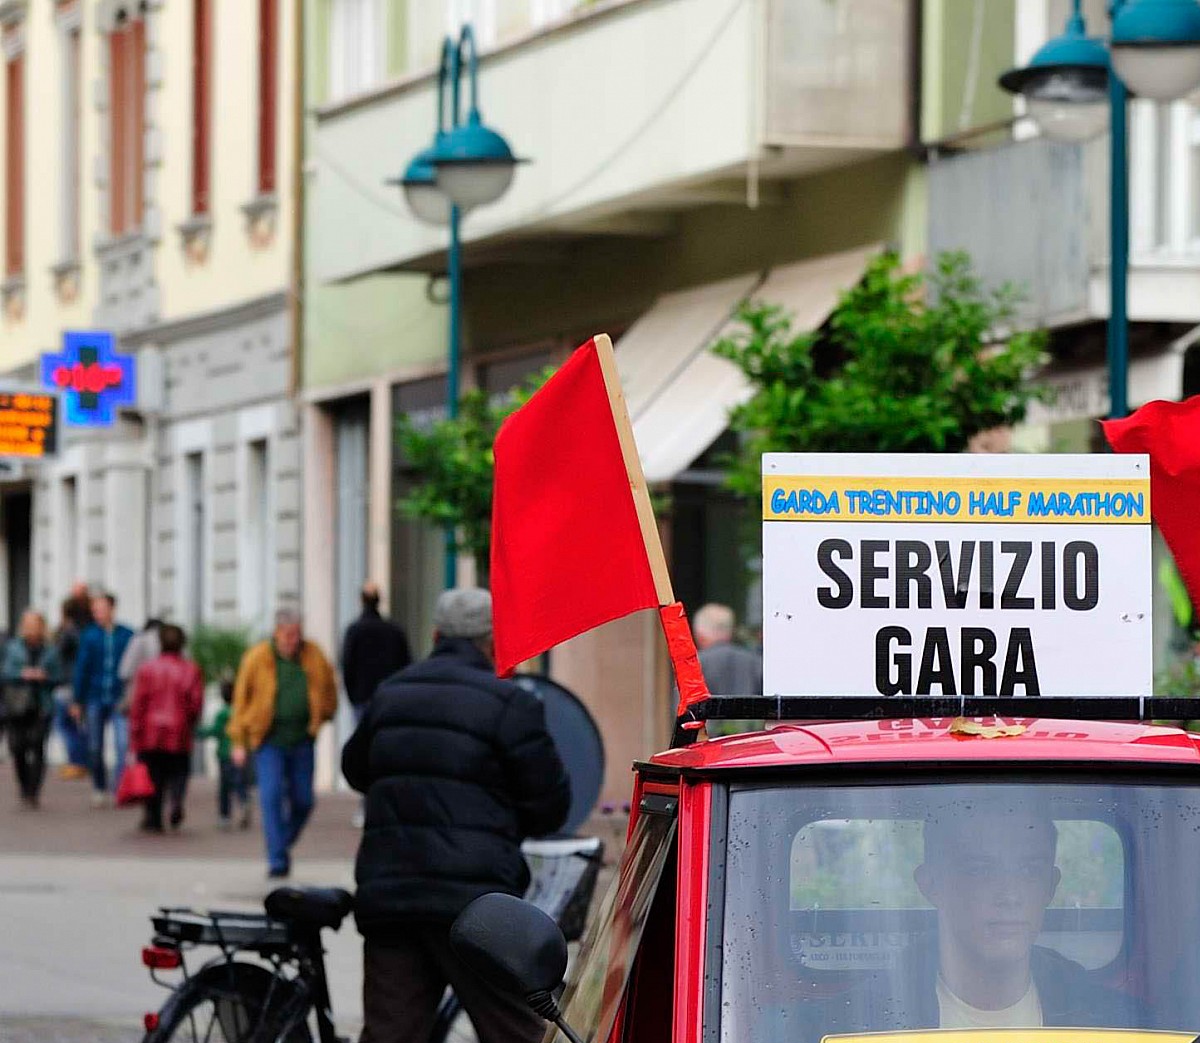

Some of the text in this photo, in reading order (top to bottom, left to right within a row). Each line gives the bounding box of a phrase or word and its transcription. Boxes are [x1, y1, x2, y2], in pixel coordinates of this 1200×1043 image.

[771, 488, 1144, 517] GARDA TRENTINO HALF MARATHON
[817, 538, 1099, 611] SERVIZIO
[875, 625, 1041, 697] GARA
